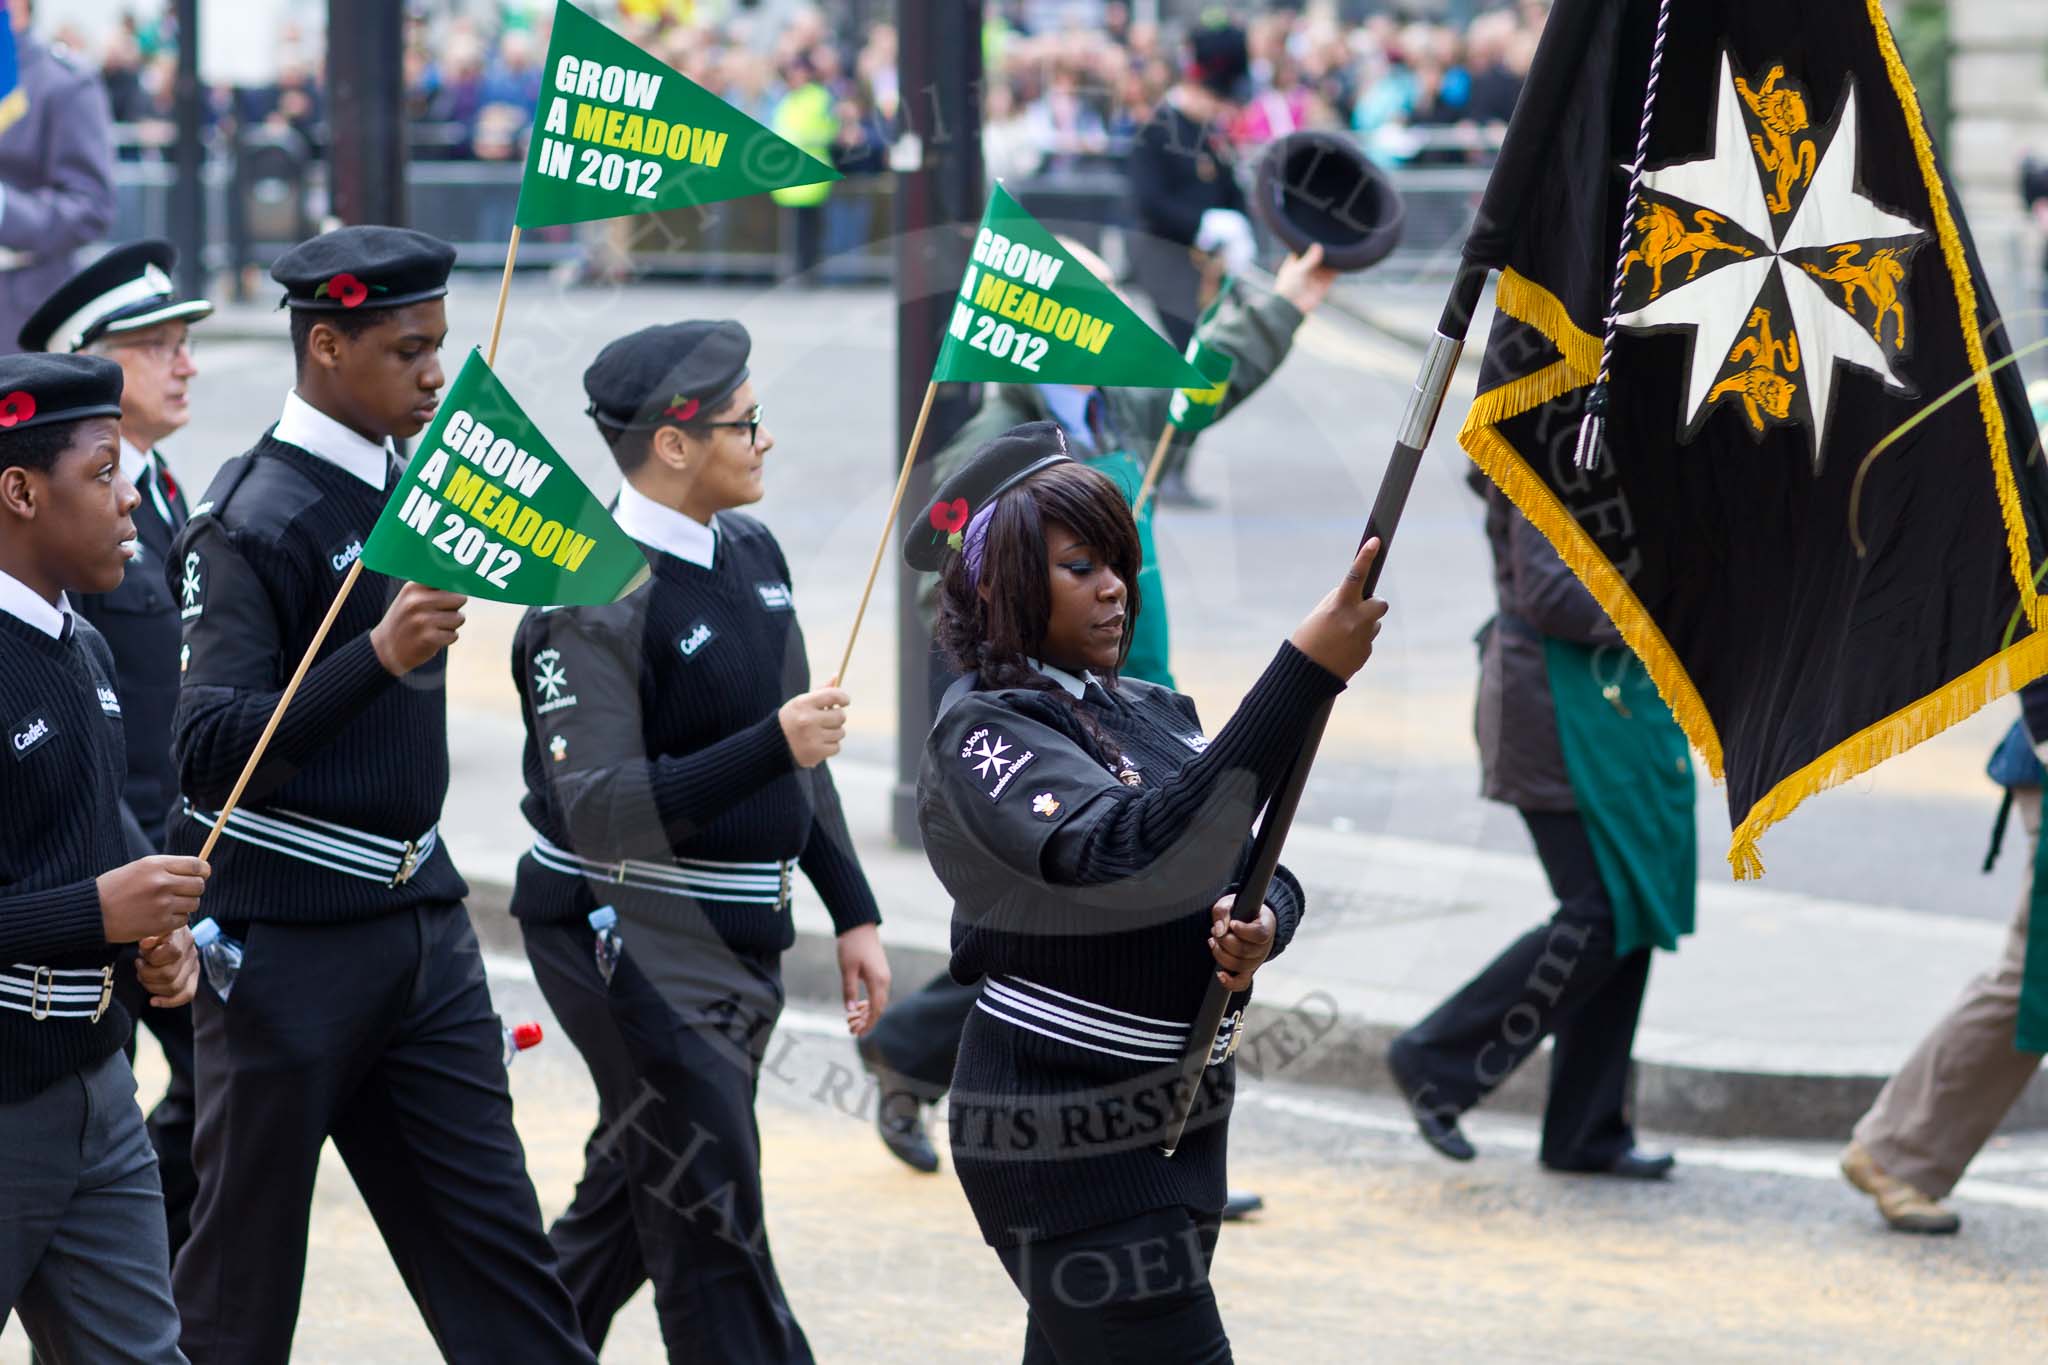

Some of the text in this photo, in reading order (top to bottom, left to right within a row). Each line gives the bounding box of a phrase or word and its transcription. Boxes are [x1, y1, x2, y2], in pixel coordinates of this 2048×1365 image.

[555, 55, 663, 111] GROW
[544, 97, 728, 168] A MEADOW
[537, 138, 663, 199] IN 2012
[973, 227, 1063, 290] GROW
[969, 316, 1049, 373] 2012
[974, 273, 1114, 355] MEADOW
[442, 410, 553, 499] GROW
[397, 485, 522, 590] IN 2012
[417, 448, 596, 573] A MEADOW
[14, 717, 48, 750] Cadet
[989, 751, 1034, 798] London District
